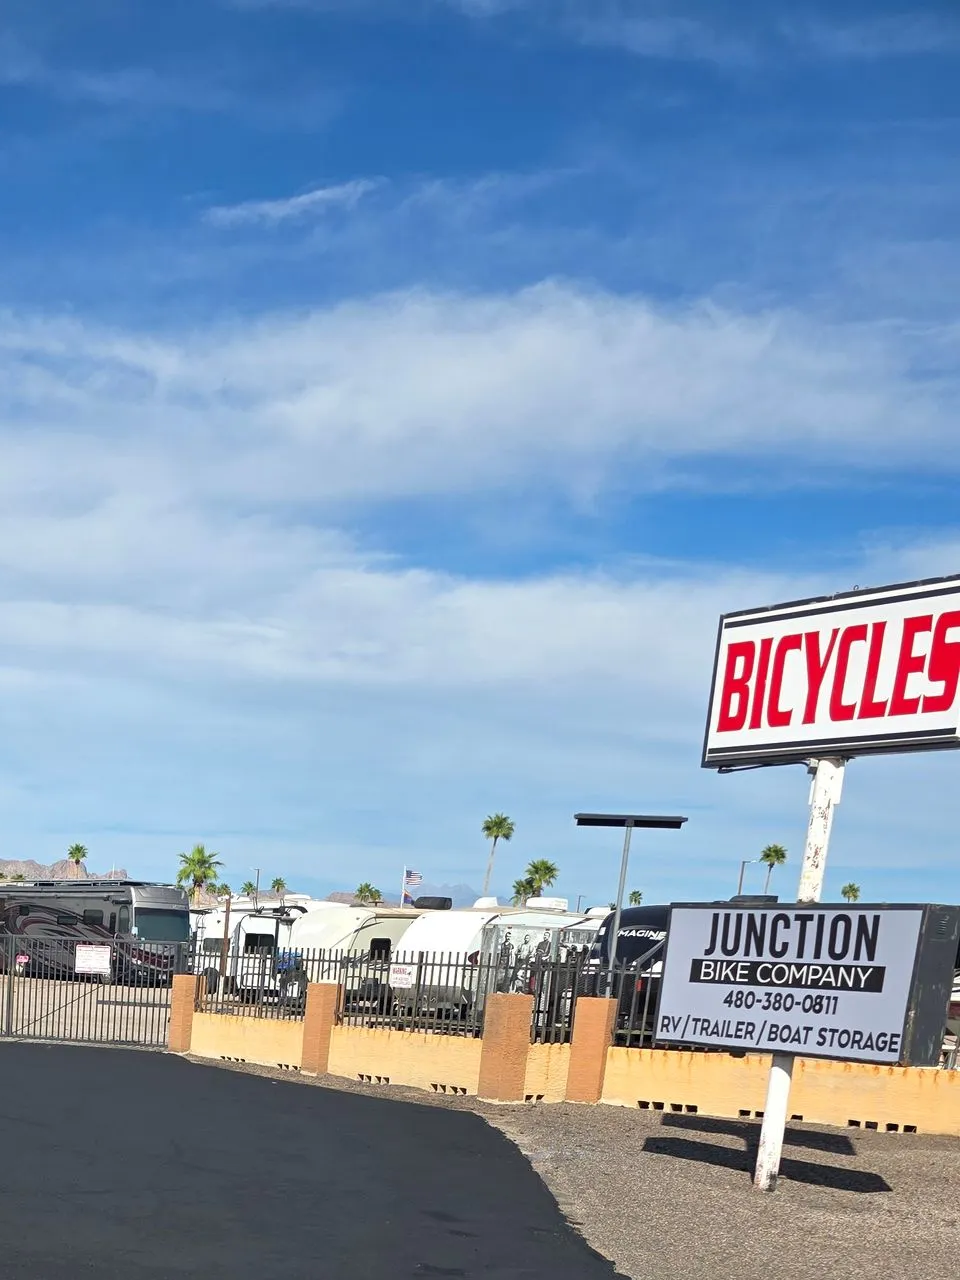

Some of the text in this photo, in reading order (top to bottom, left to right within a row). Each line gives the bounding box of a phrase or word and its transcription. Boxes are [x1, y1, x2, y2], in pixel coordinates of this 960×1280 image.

[716, 609, 960, 733] BICYCLES
[616, 929, 667, 940] MAGINE
[704, 912, 881, 962] JUNCTION
[700, 961, 873, 988] BIKE COMPANY
[723, 990, 839, 1015] 480-380-0811
[816, 1027, 901, 1053] STORAGE
